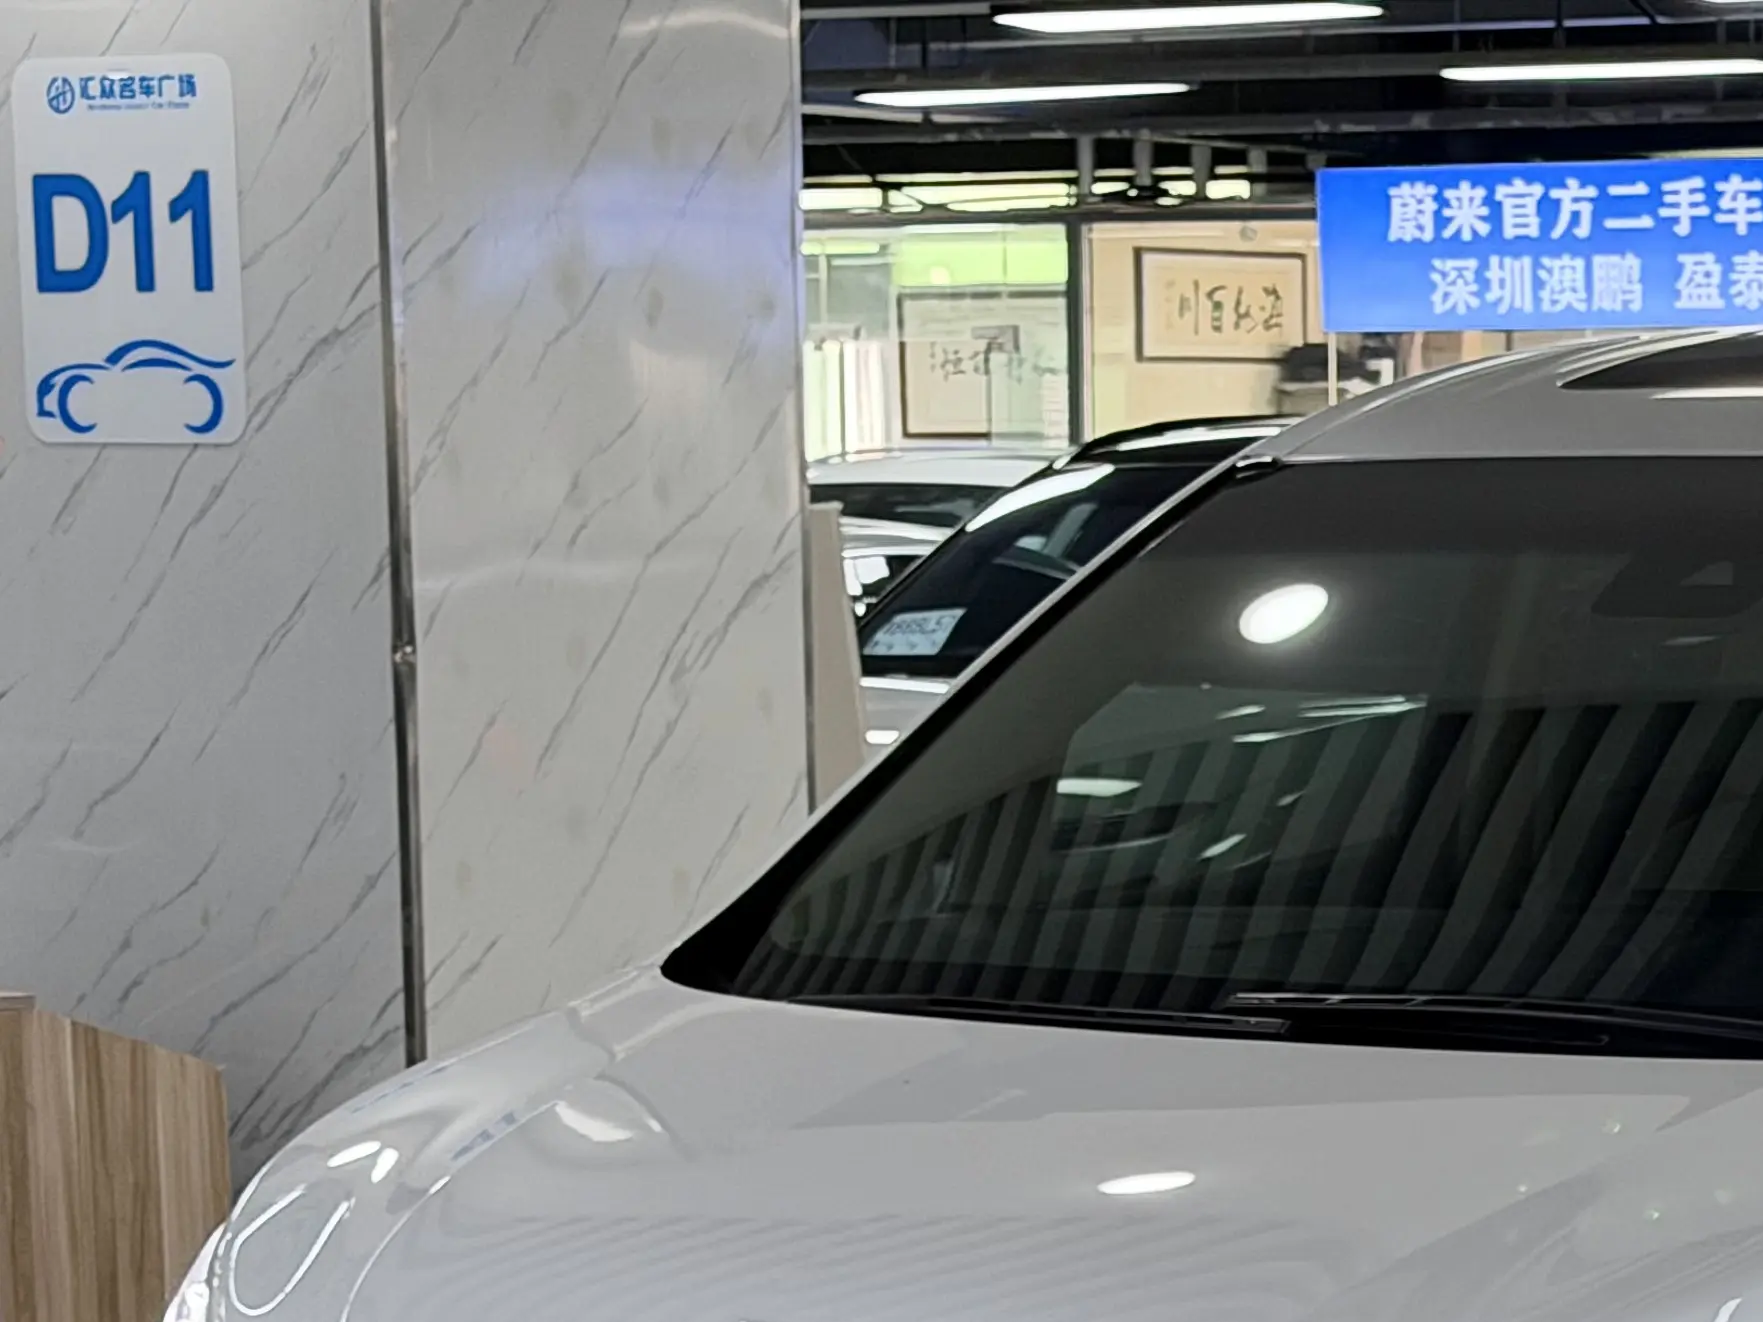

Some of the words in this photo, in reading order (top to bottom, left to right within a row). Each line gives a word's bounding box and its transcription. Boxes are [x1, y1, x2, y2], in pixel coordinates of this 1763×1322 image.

[79, 73, 197, 100] 汇众名车广场
[32, 169, 214, 293] D11
[1429, 252, 1644, 315] 深圳澳鹏
